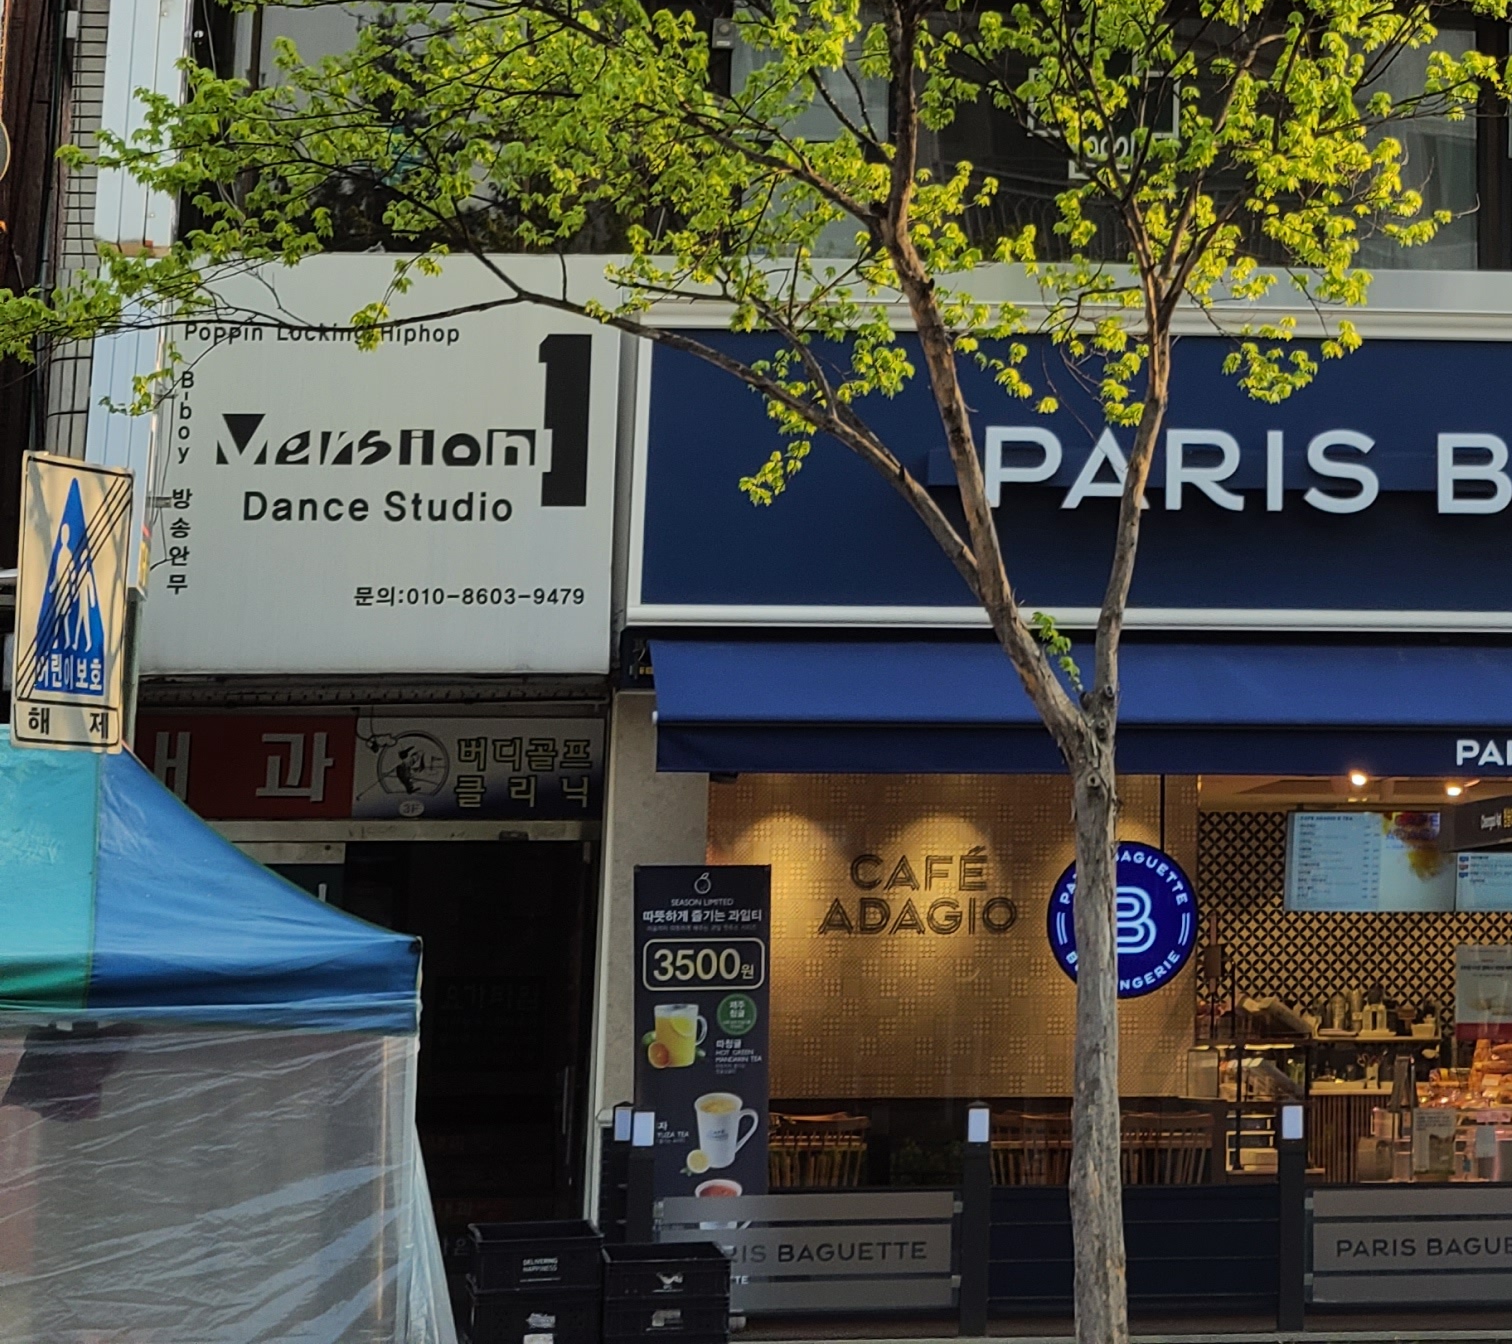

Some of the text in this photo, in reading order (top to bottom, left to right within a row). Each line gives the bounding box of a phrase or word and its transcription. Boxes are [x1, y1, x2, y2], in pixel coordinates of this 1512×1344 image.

[183, 322, 264, 346] Poppin
[379, 323, 461, 348] Hiphop
[984, 425, 1381, 514] PARIS
[242, 490, 514, 523] Dance Studio
[165, 486, 194, 596] 방송안무
[352, 585, 586, 607] 문의:010-8603-9479
[456, 736, 594, 773] 버디골프
[849, 845, 988, 892] CAFÉ
[642, 909, 689, 924] 따뜻하게
[690, 909, 726, 923] 즐기는
[670, 896, 734, 907] SEASON LIMITED
[817, 896, 1018, 936] ADAGIO
[652, 948, 755, 981] 3500원
[731, 1241, 928, 1264] RIS BAGUETTE
[1334, 1235, 1417, 1260] PARIS
